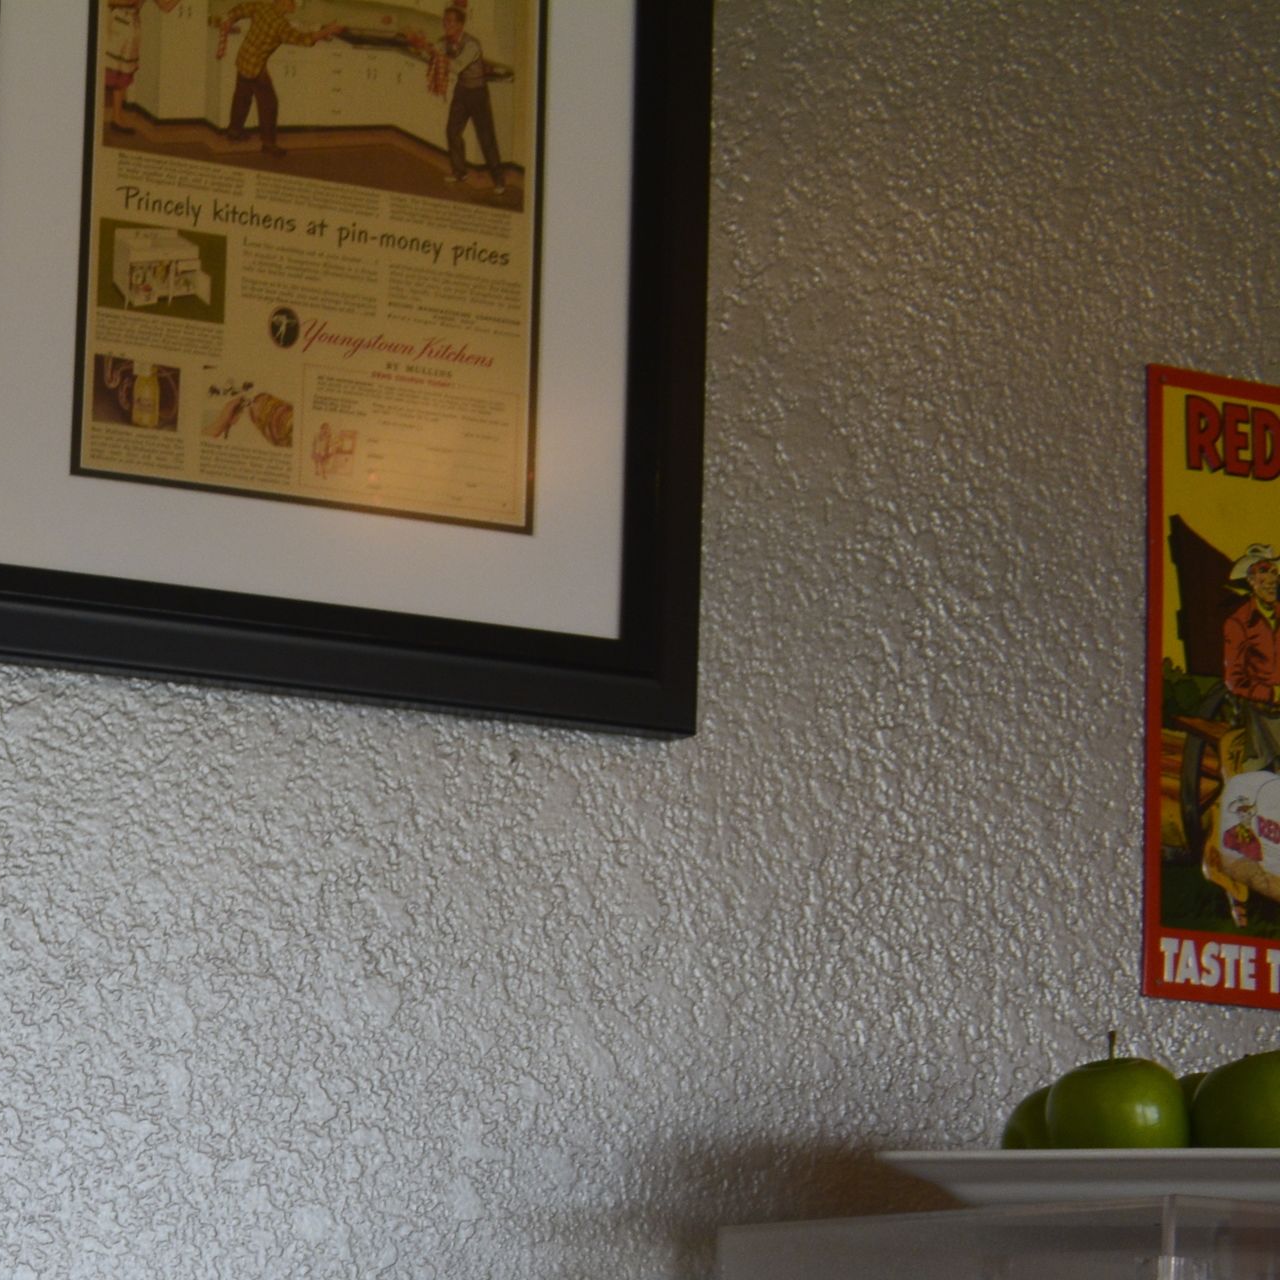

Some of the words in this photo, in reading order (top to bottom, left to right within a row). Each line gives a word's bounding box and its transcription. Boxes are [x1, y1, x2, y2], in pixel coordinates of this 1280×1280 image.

[117, 185, 201, 226] Princely
[212, 199, 297, 233] kitchens
[306, 219, 329, 237] at
[337, 222, 443, 262] pin-money
[452, 241, 511, 268] prices
[302, 318, 414, 359] Youngstown
[412, 336, 494, 368] Kitchens
[1185, 394, 1280, 482] RED
[1160, 937, 1257, 991] TASTE
